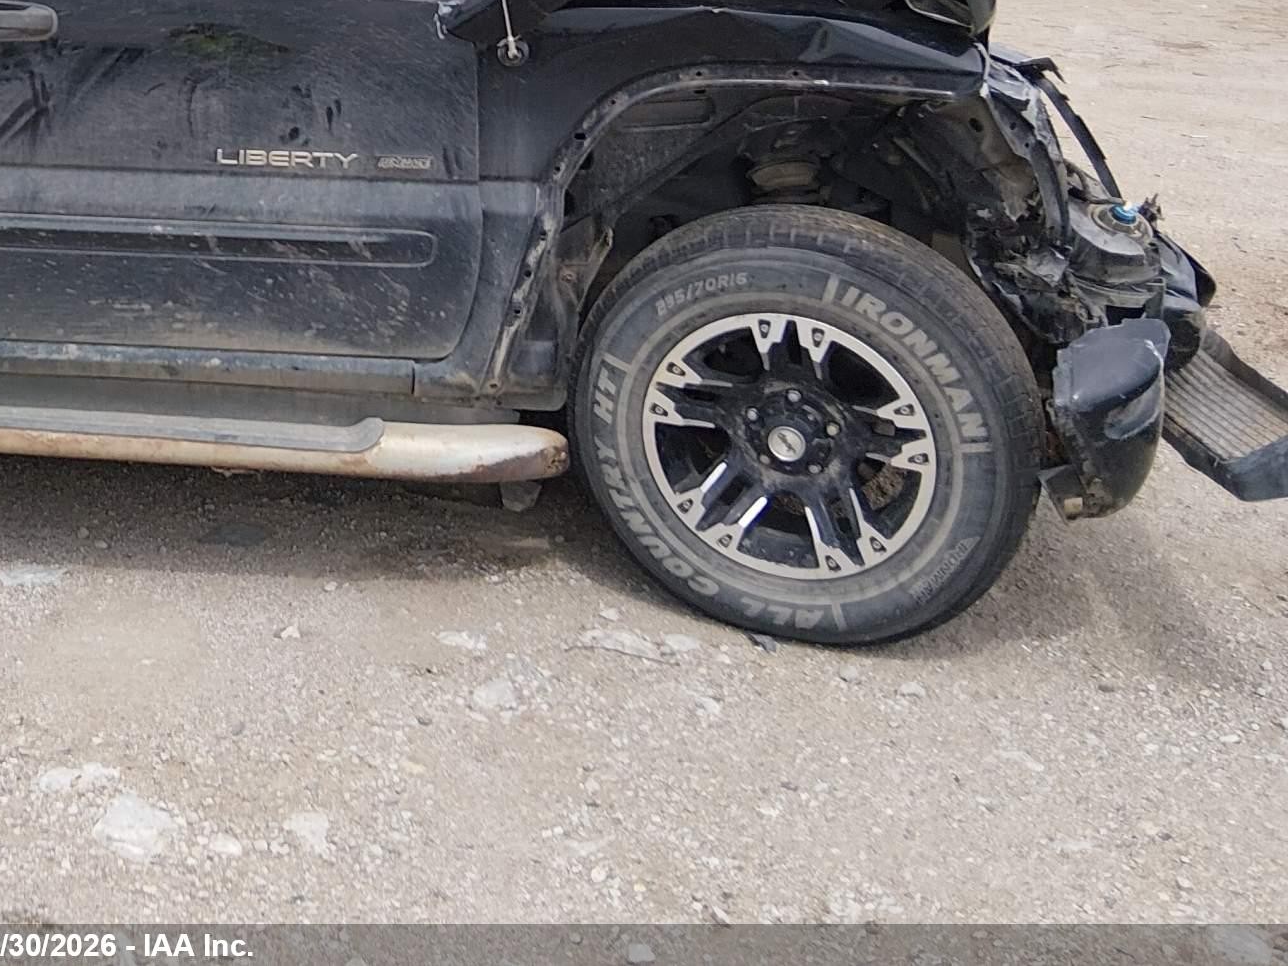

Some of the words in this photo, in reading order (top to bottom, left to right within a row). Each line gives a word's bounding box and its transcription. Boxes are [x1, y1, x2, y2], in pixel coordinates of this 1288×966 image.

[216, 148, 359, 169] LIBERTY
[841, 286, 989, 437] IRONMAN
[592, 366, 617, 425] HT
[593, 434, 720, 596] COUNTRY
[740, 596, 825, 630] ALL
